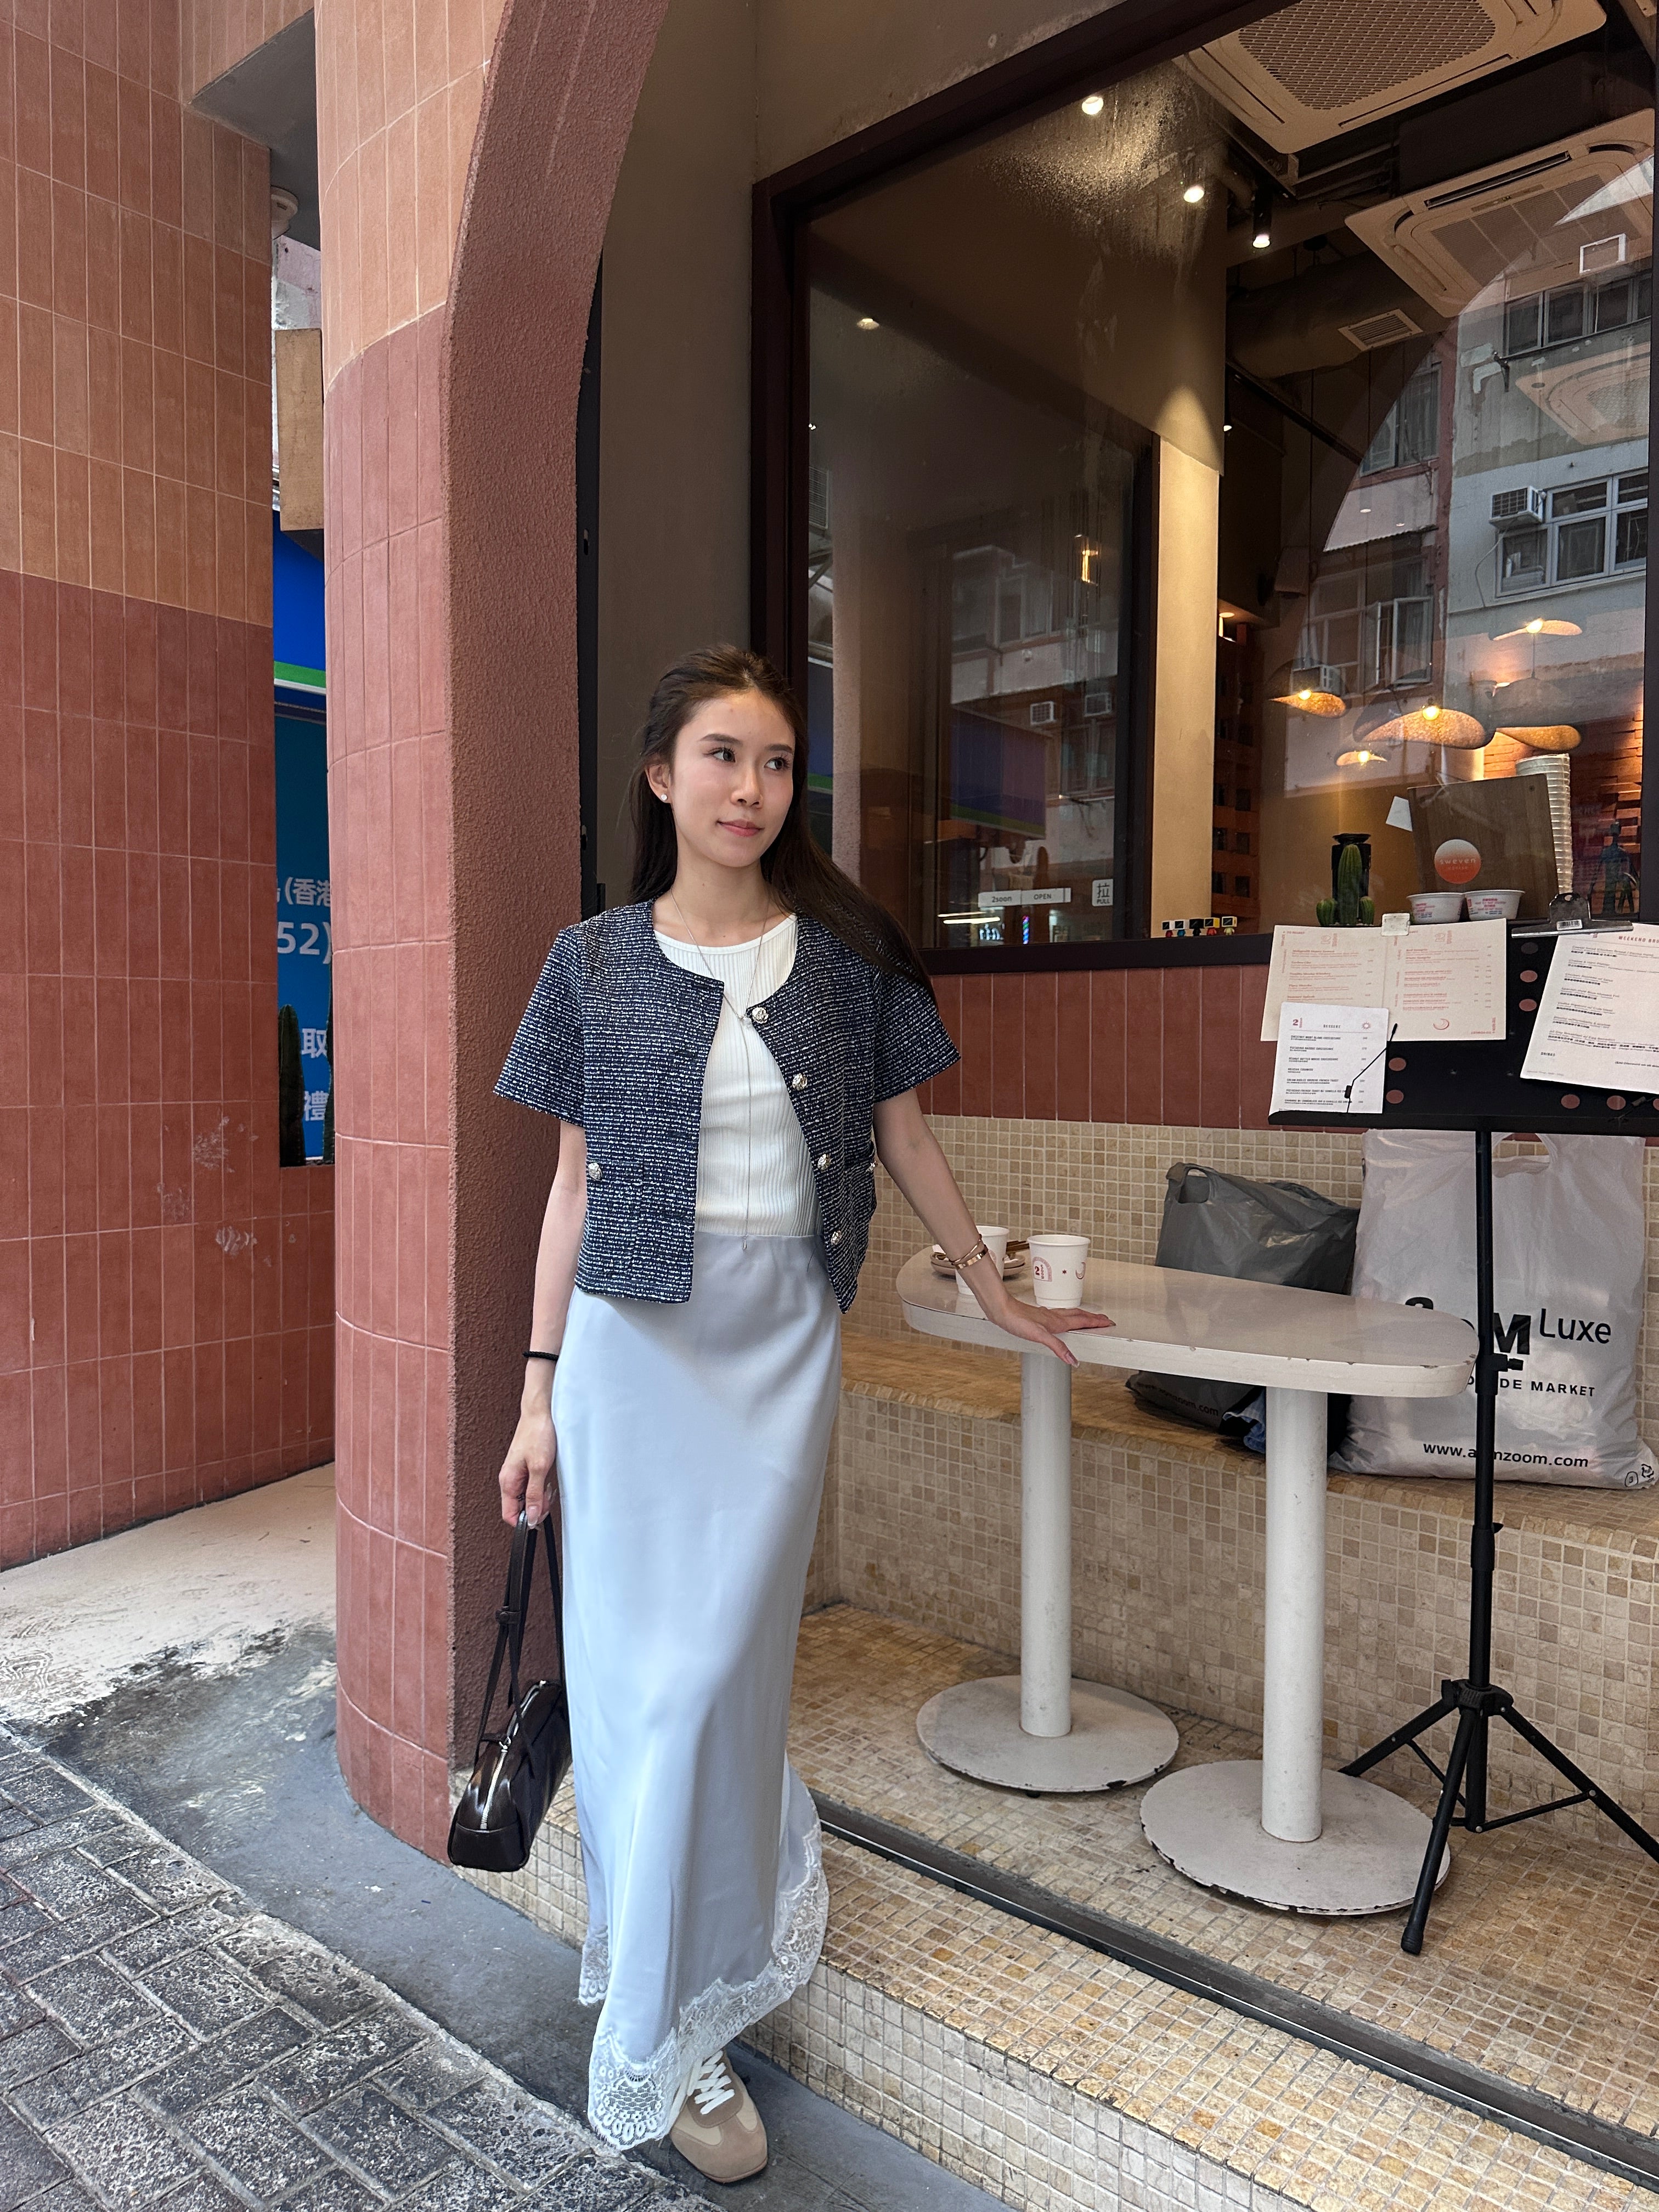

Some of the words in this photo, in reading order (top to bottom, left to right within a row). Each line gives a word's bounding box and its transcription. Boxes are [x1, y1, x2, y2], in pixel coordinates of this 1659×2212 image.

[277, 876, 331, 907] (香港
[1097, 883, 1110, 899] 拉
[301, 1028, 328, 1059] 取
[1539, 1308, 1612, 1344] Luxe
[1531, 1380, 1595, 1397] MARKET
